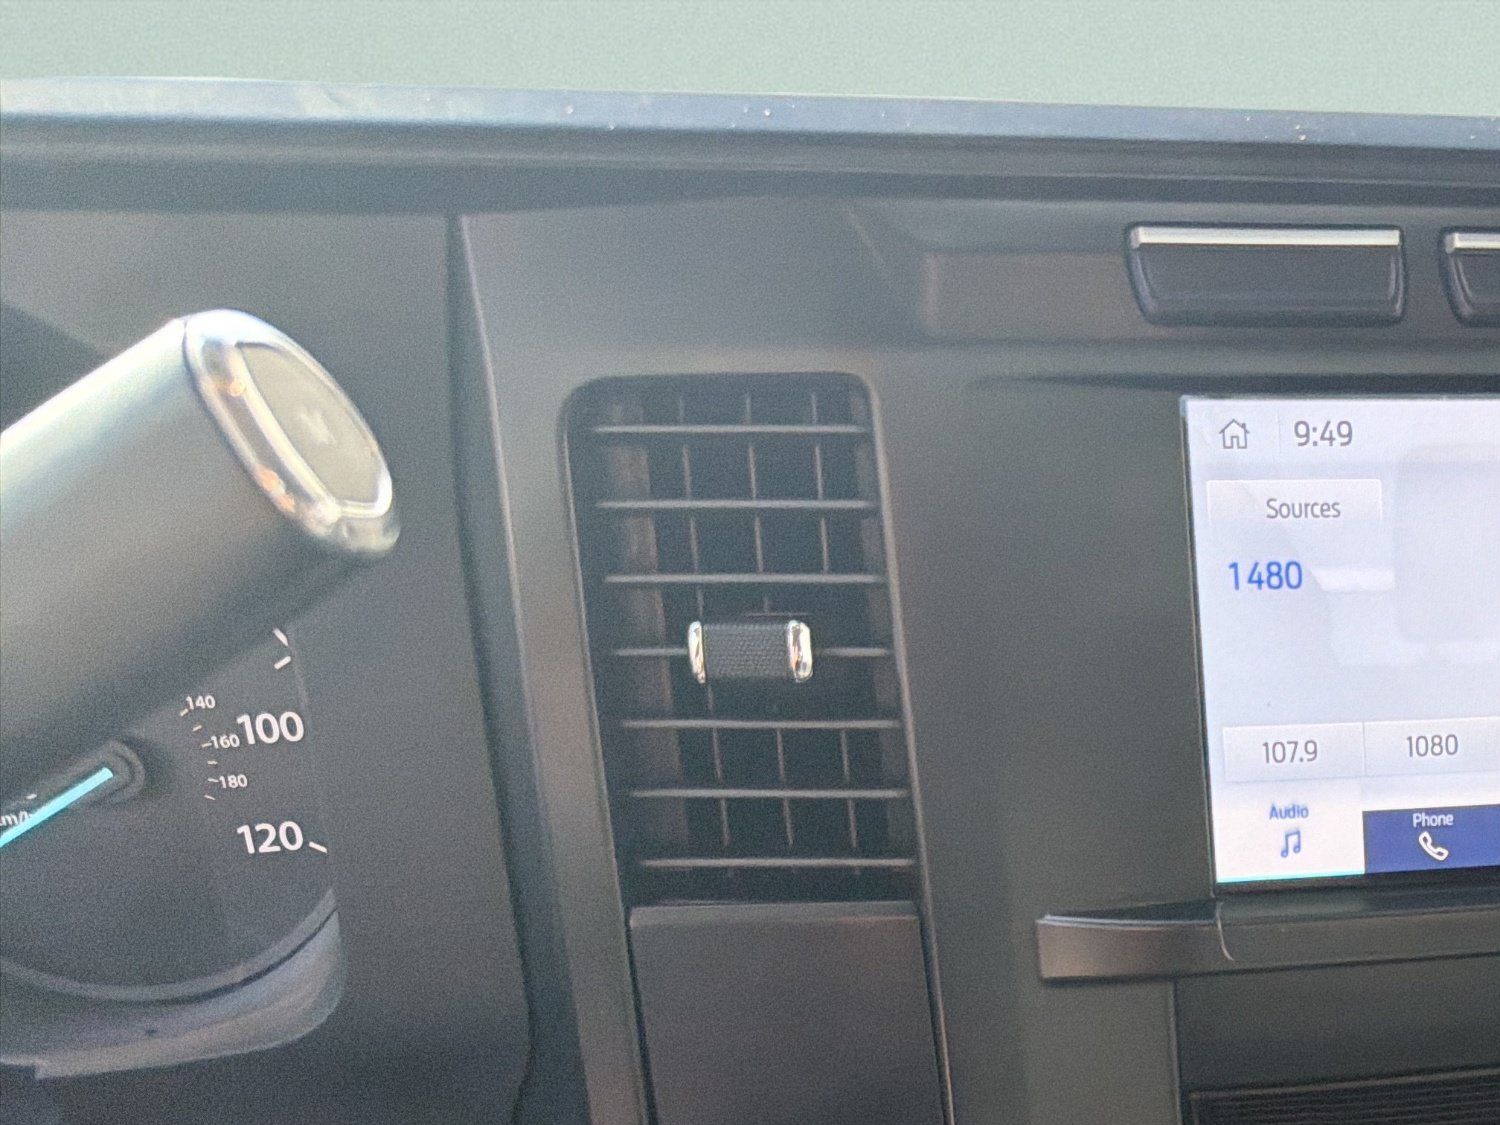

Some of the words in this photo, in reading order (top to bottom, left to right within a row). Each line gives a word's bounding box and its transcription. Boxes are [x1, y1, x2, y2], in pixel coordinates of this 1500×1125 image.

[1293, 420, 1353, 447] 9:49
[1266, 498, 1341, 519] Sources
[1228, 561, 1303, 591] 1480
[185, 695, 216, 710] 140
[237, 711, 305, 745] 100
[211, 734, 240, 749] 160
[1262, 740, 1318, 764] 107.9
[1406, 734, 1459, 758] 1080
[219, 775, 248, 788] 180
[1269, 804, 1309, 820] Audio
[1413, 812, 1454, 827] Phone
[237, 821, 304, 854] 120
